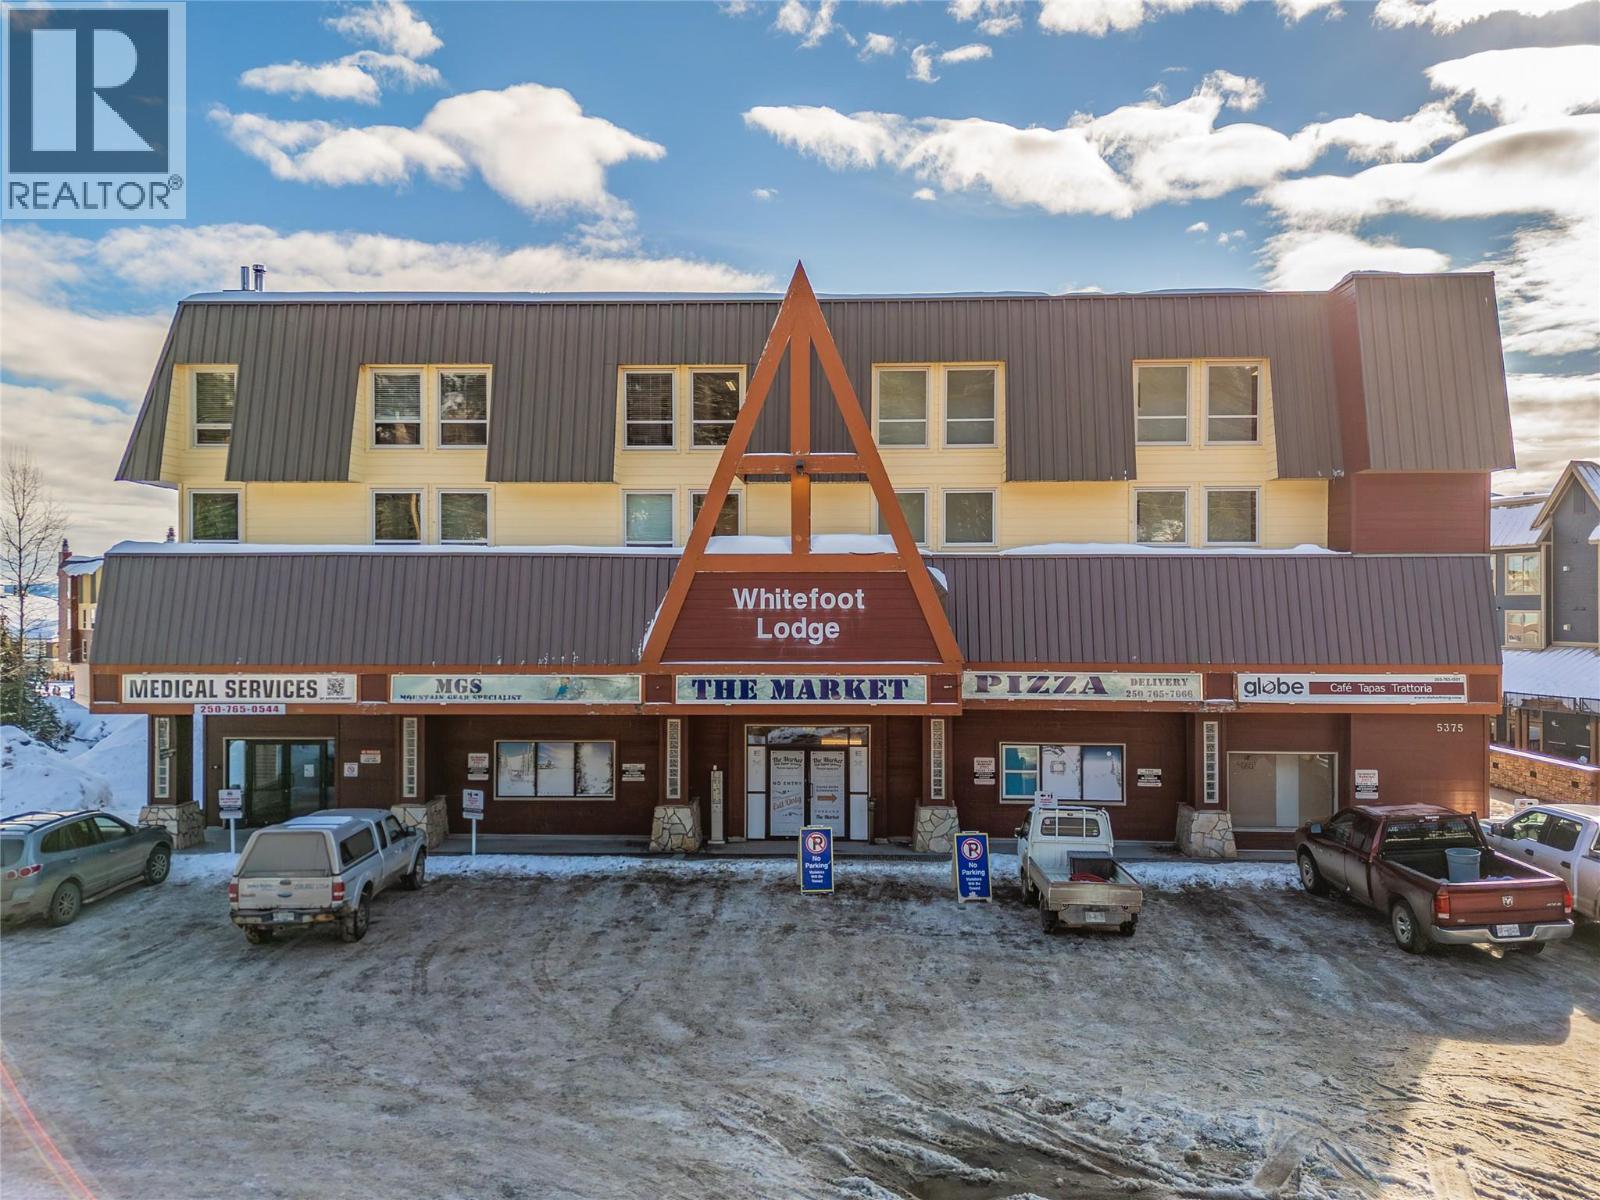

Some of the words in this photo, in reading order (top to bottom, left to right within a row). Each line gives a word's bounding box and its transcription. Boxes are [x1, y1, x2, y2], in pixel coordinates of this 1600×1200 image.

[732, 588, 865, 610] Whitefoot
[757, 617, 840, 645] Lodge
[129, 679, 218, 698] MEDICAL
[225, 679, 318, 699] SERVICES
[435, 678, 482, 693] MGS
[692, 679, 757, 700] THE
[770, 679, 909, 700] MARKET
[974, 674, 1109, 694] PIZZA
[1130, 678, 1189, 687] DELIVERY
[1243, 677, 1305, 697] globe
[1330, 682, 1352, 693] Café
[1358, 683, 1386, 694] Tapas
[1391, 683, 1433, 693] Trattoria
[1125, 690, 1144, 698] 250
[200, 705, 279, 713] 250-765-0544
[1436, 723, 1464, 732] 5375
